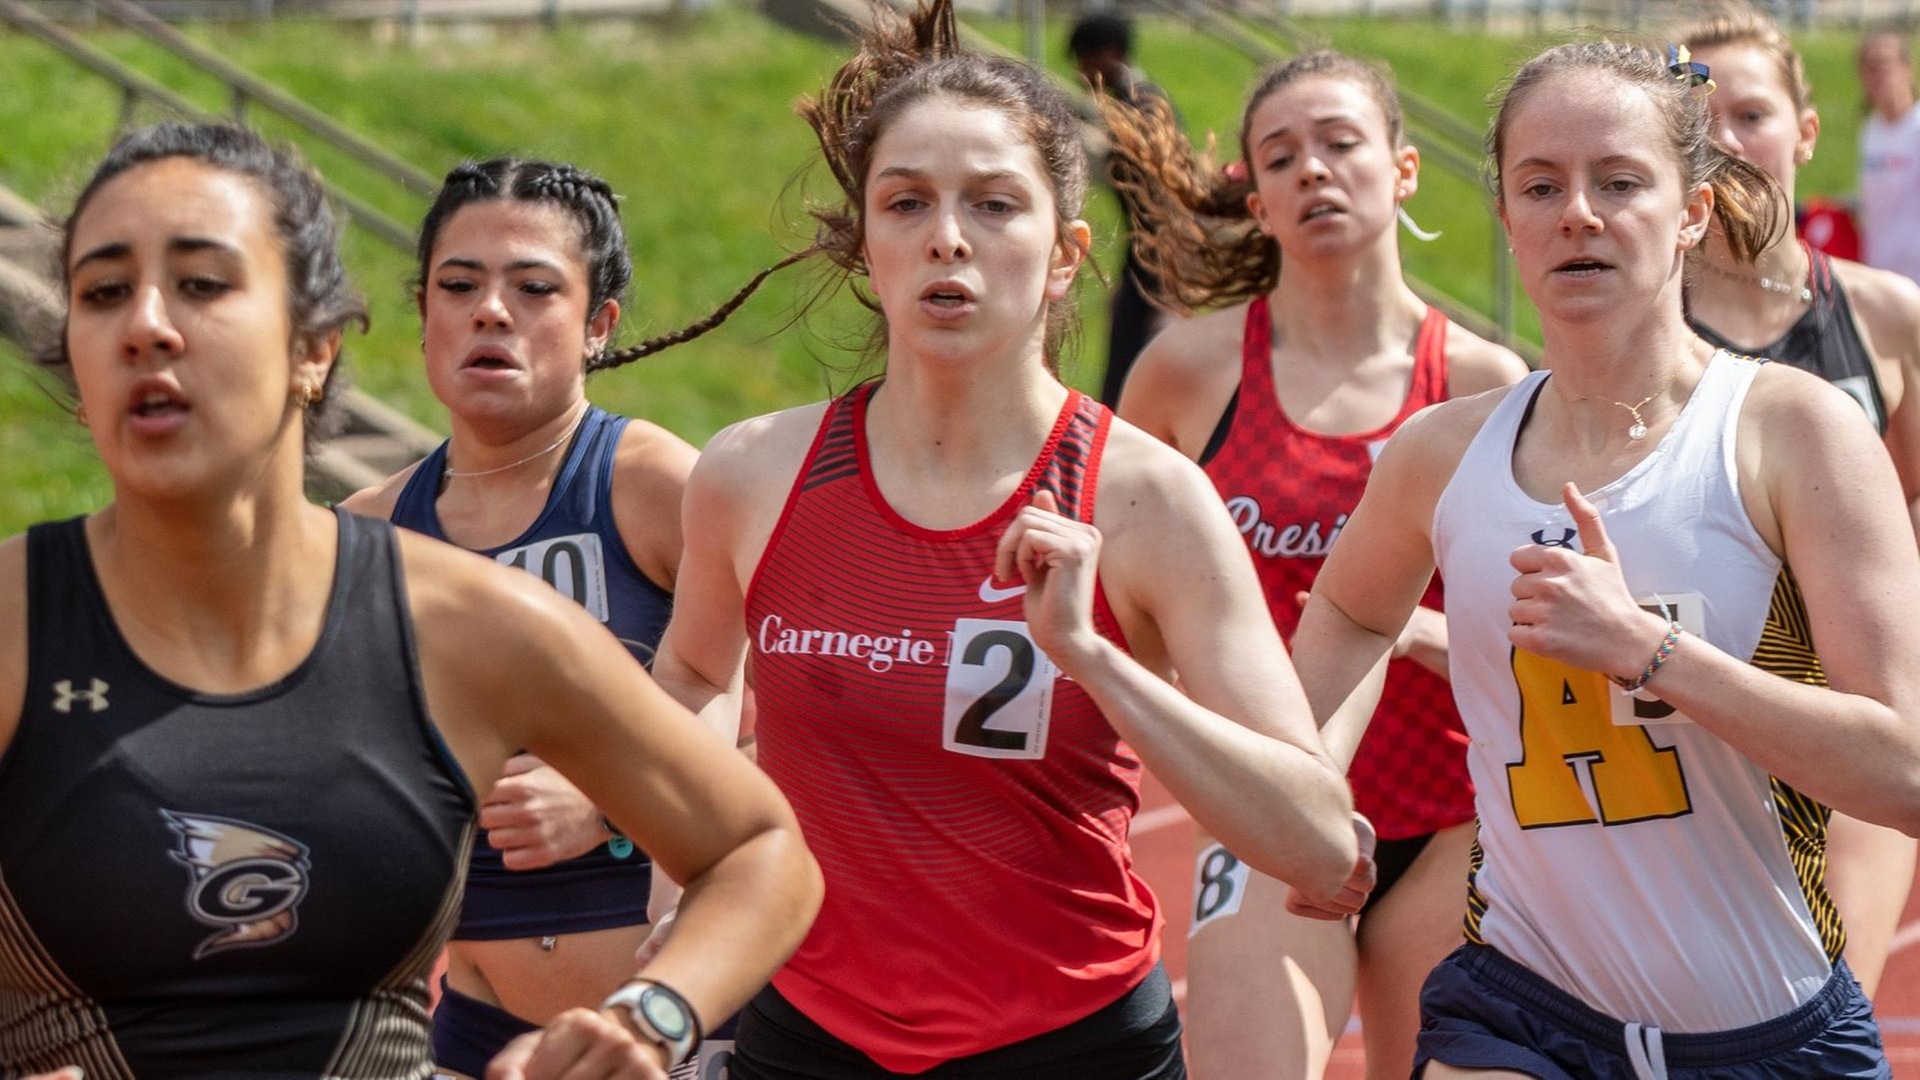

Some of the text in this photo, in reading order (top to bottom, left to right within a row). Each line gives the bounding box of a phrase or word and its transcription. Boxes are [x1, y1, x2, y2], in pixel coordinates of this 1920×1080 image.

[759, 615, 935, 673] Carnegie
[954, 629, 1035, 751] 2
[1505, 644, 1694, 831] A
[193, 857, 302, 923] G
[1196, 848, 1239, 922] 8
